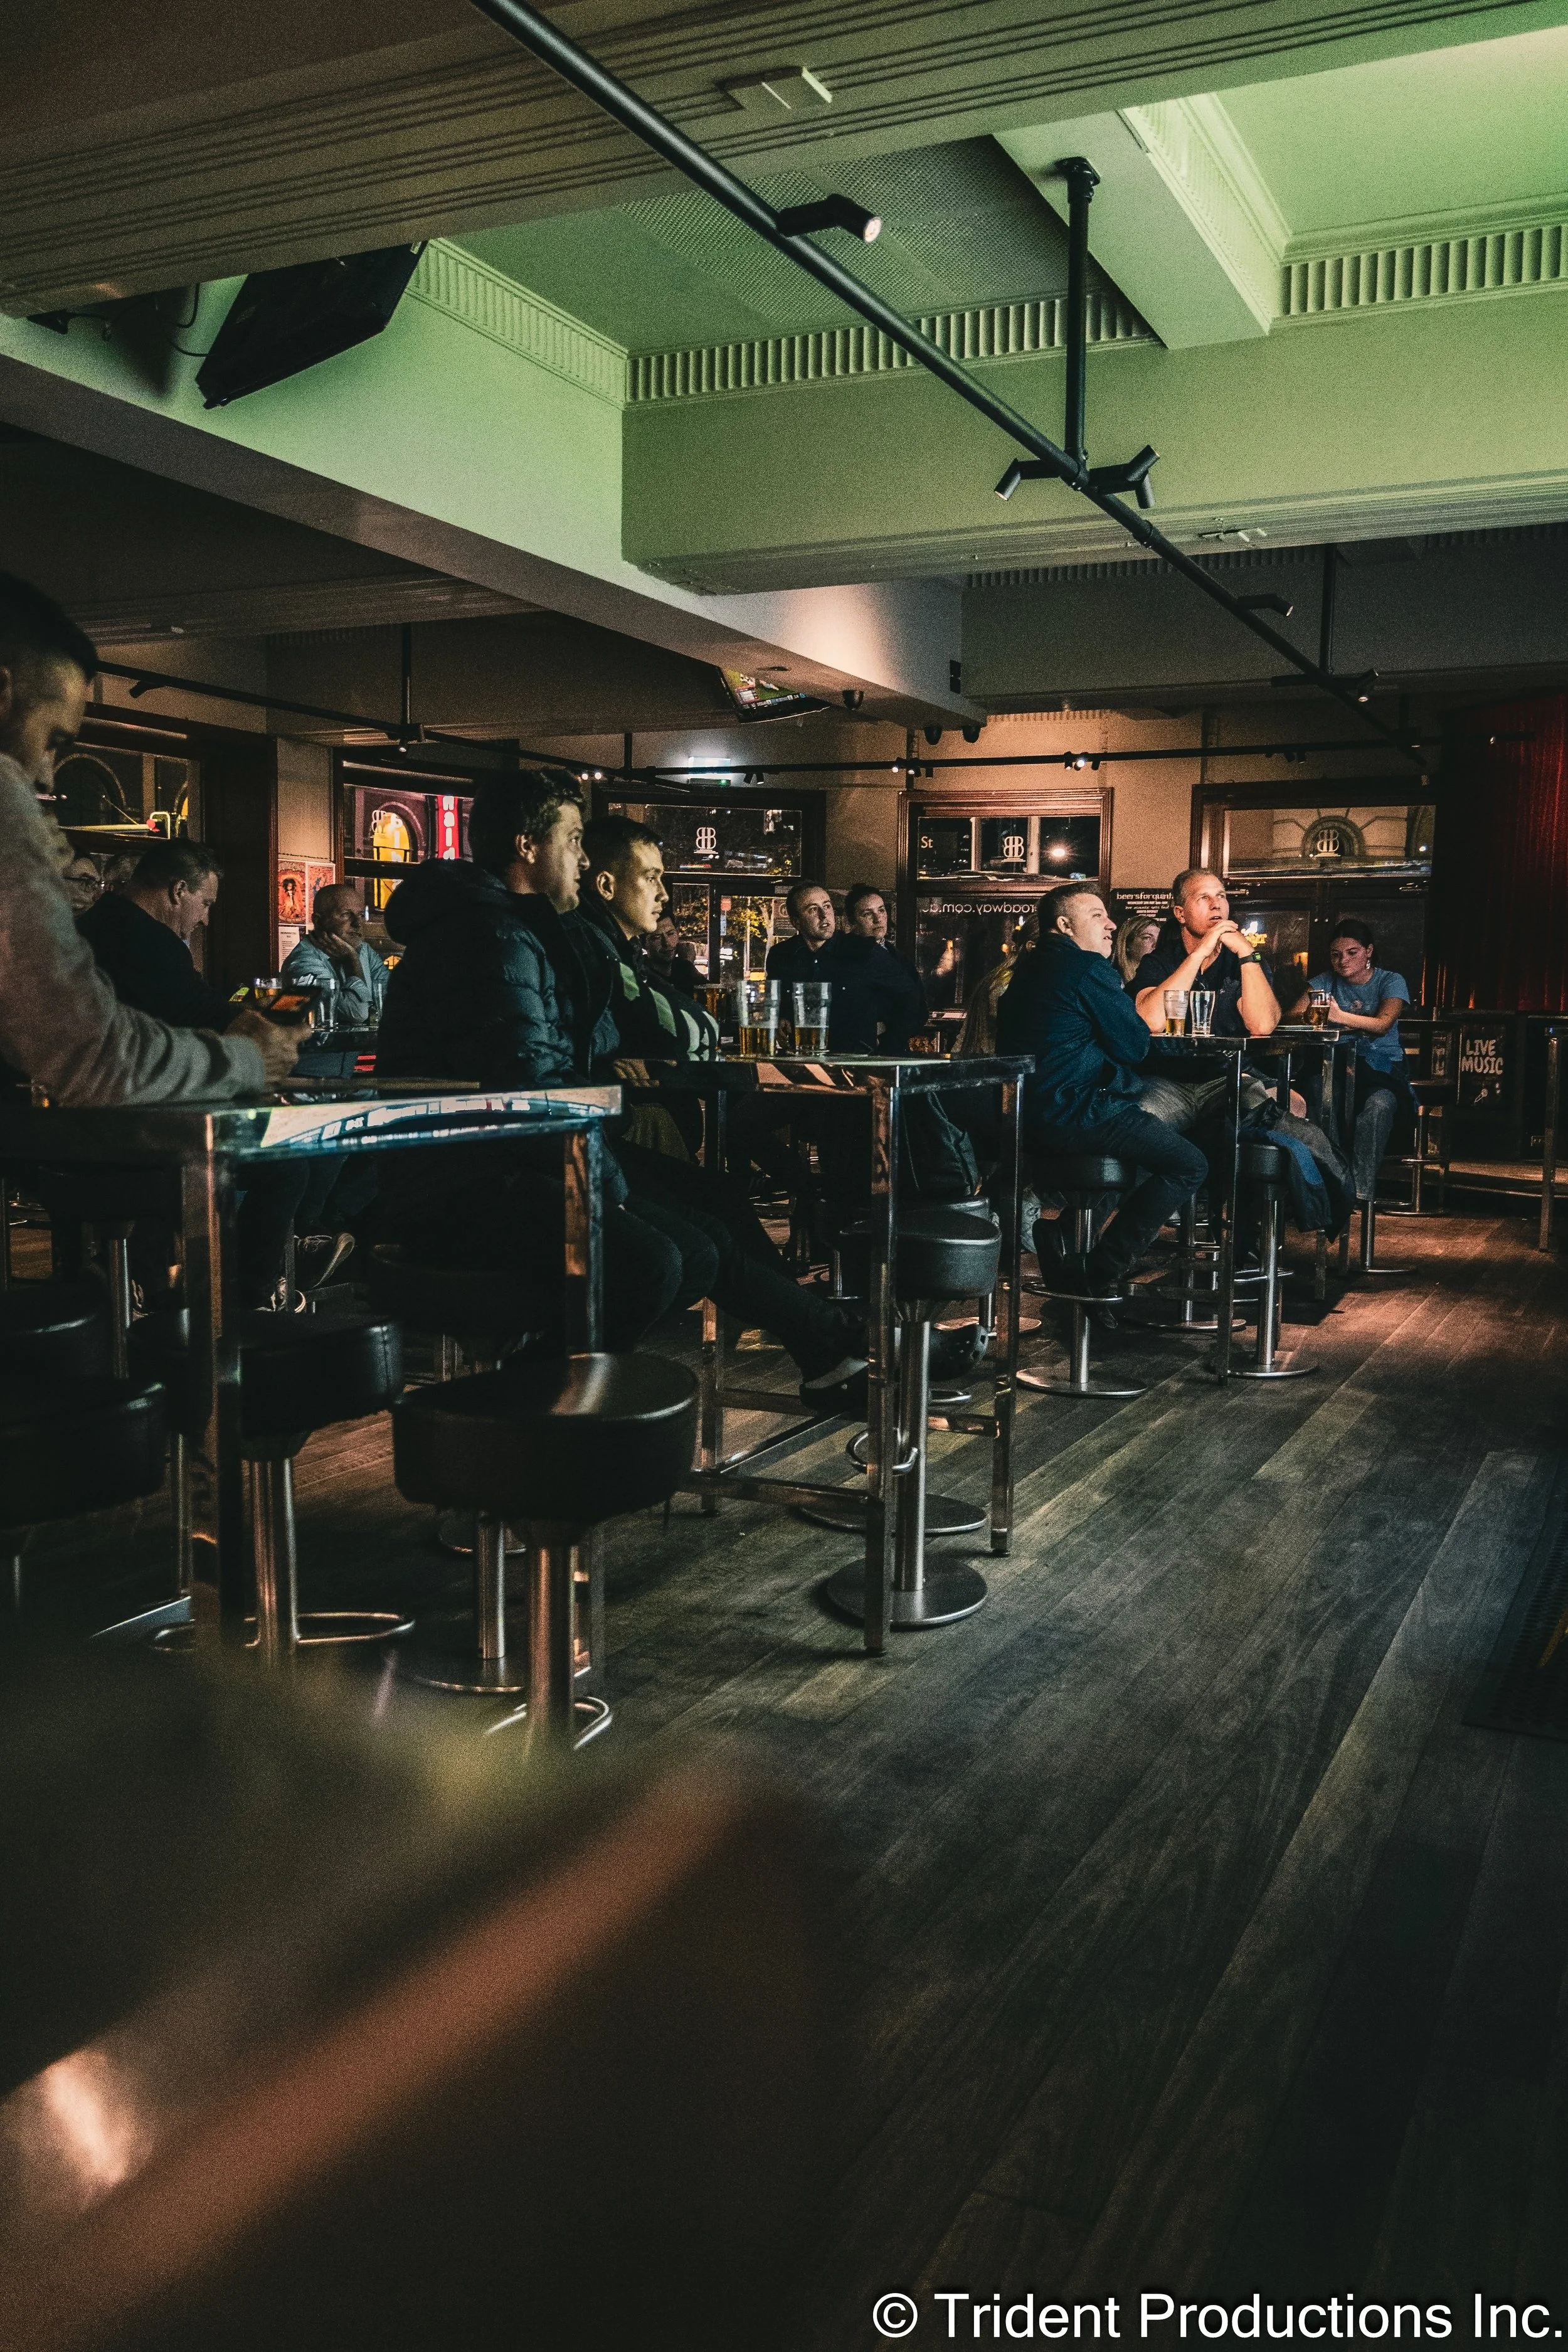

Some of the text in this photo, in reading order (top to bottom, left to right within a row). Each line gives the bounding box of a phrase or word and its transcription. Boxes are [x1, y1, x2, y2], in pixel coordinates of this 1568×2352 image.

[921, 836, 933, 849] St
[1466, 1039, 1496, 1056] LIVE
[1461, 1056, 1503, 1074] MUSIC
